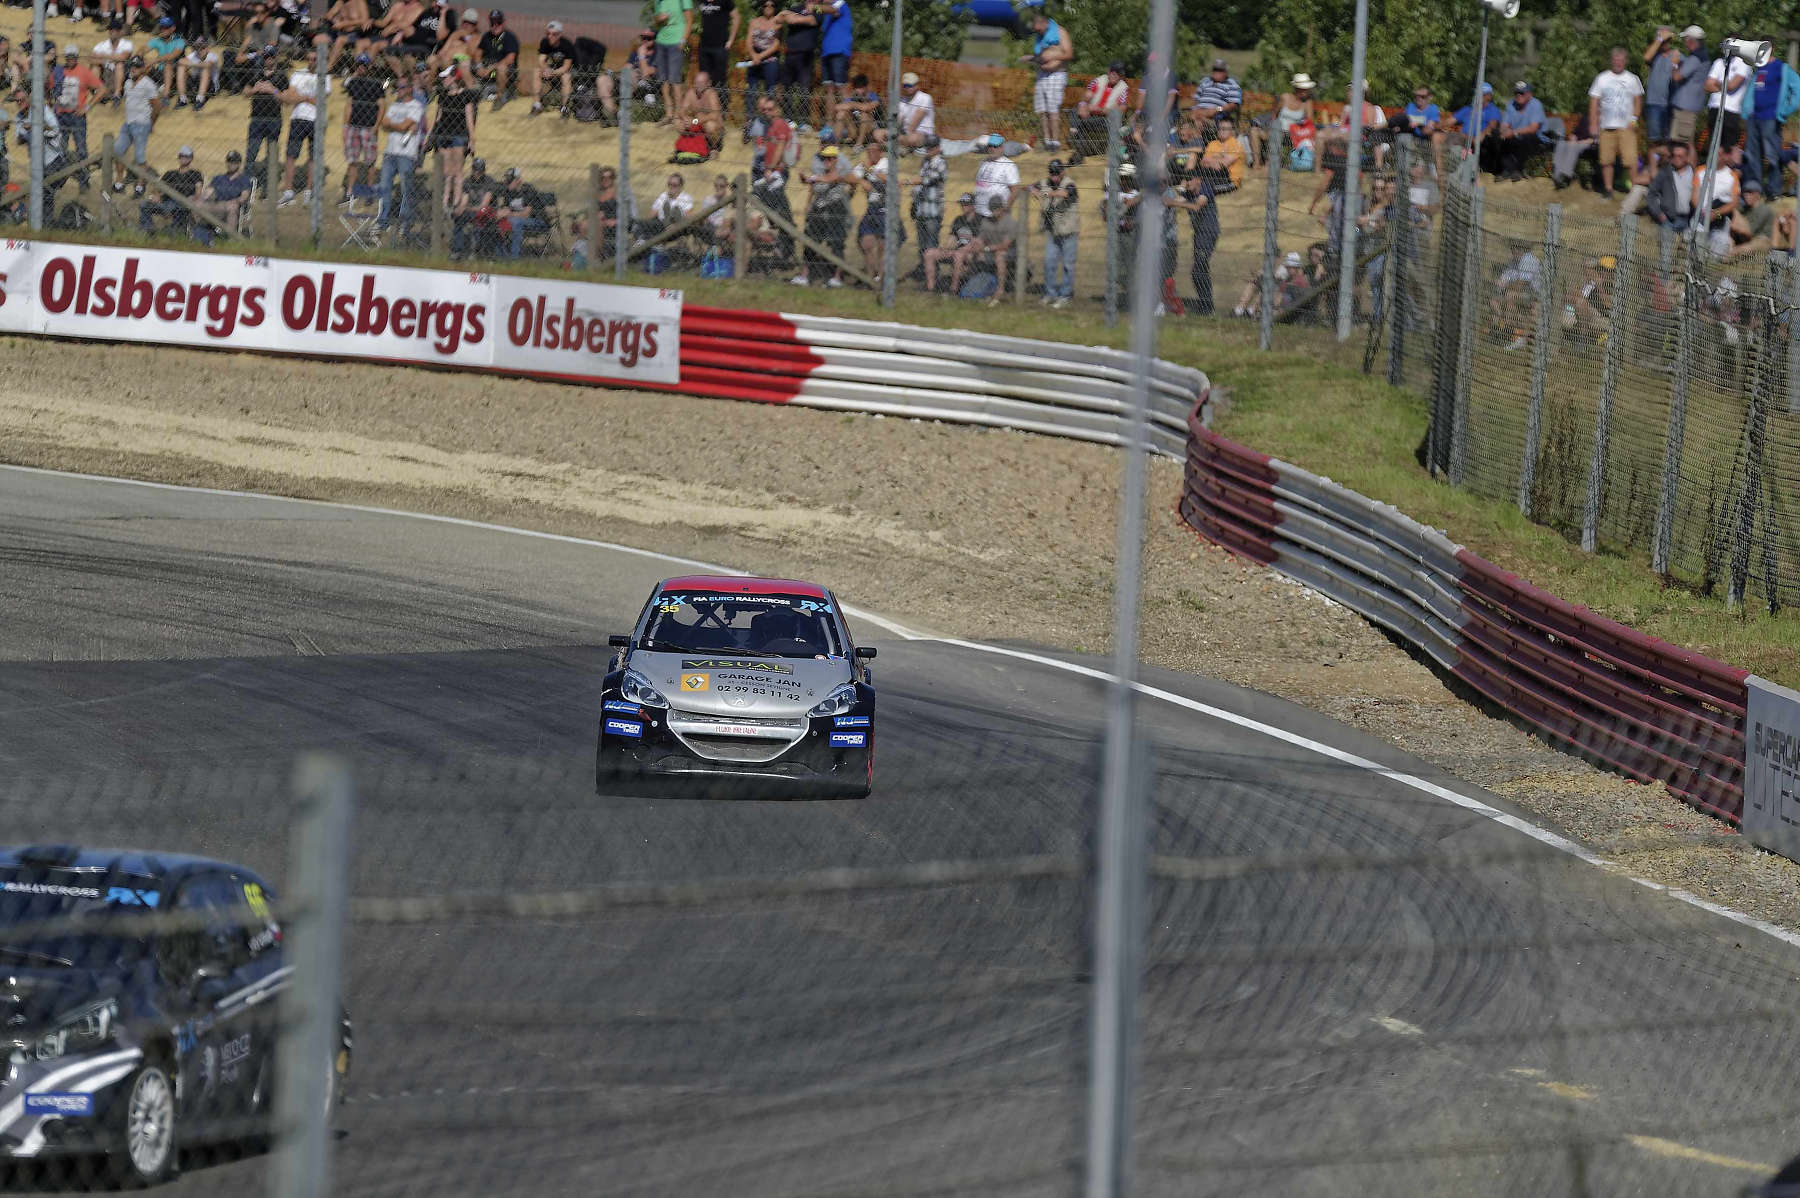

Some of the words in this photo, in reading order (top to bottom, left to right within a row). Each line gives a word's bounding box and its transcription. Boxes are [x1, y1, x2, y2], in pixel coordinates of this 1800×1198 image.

[41, 255, 266, 338] Olsbergs
[283, 273, 486, 356] Olsbergs
[508, 296, 659, 367] Olsbergs
[735, 596, 791, 605] RALLYCROSS
[660, 605, 680, 613] 35
[686, 660, 787, 671] VISUAL
[718, 673, 773, 683] GARAGE
[776, 679, 801, 688] JAN
[786, 693, 801, 701] 42
[608, 721, 640, 730] COOPER
[5, 881, 100, 897] RALLYCROSS
